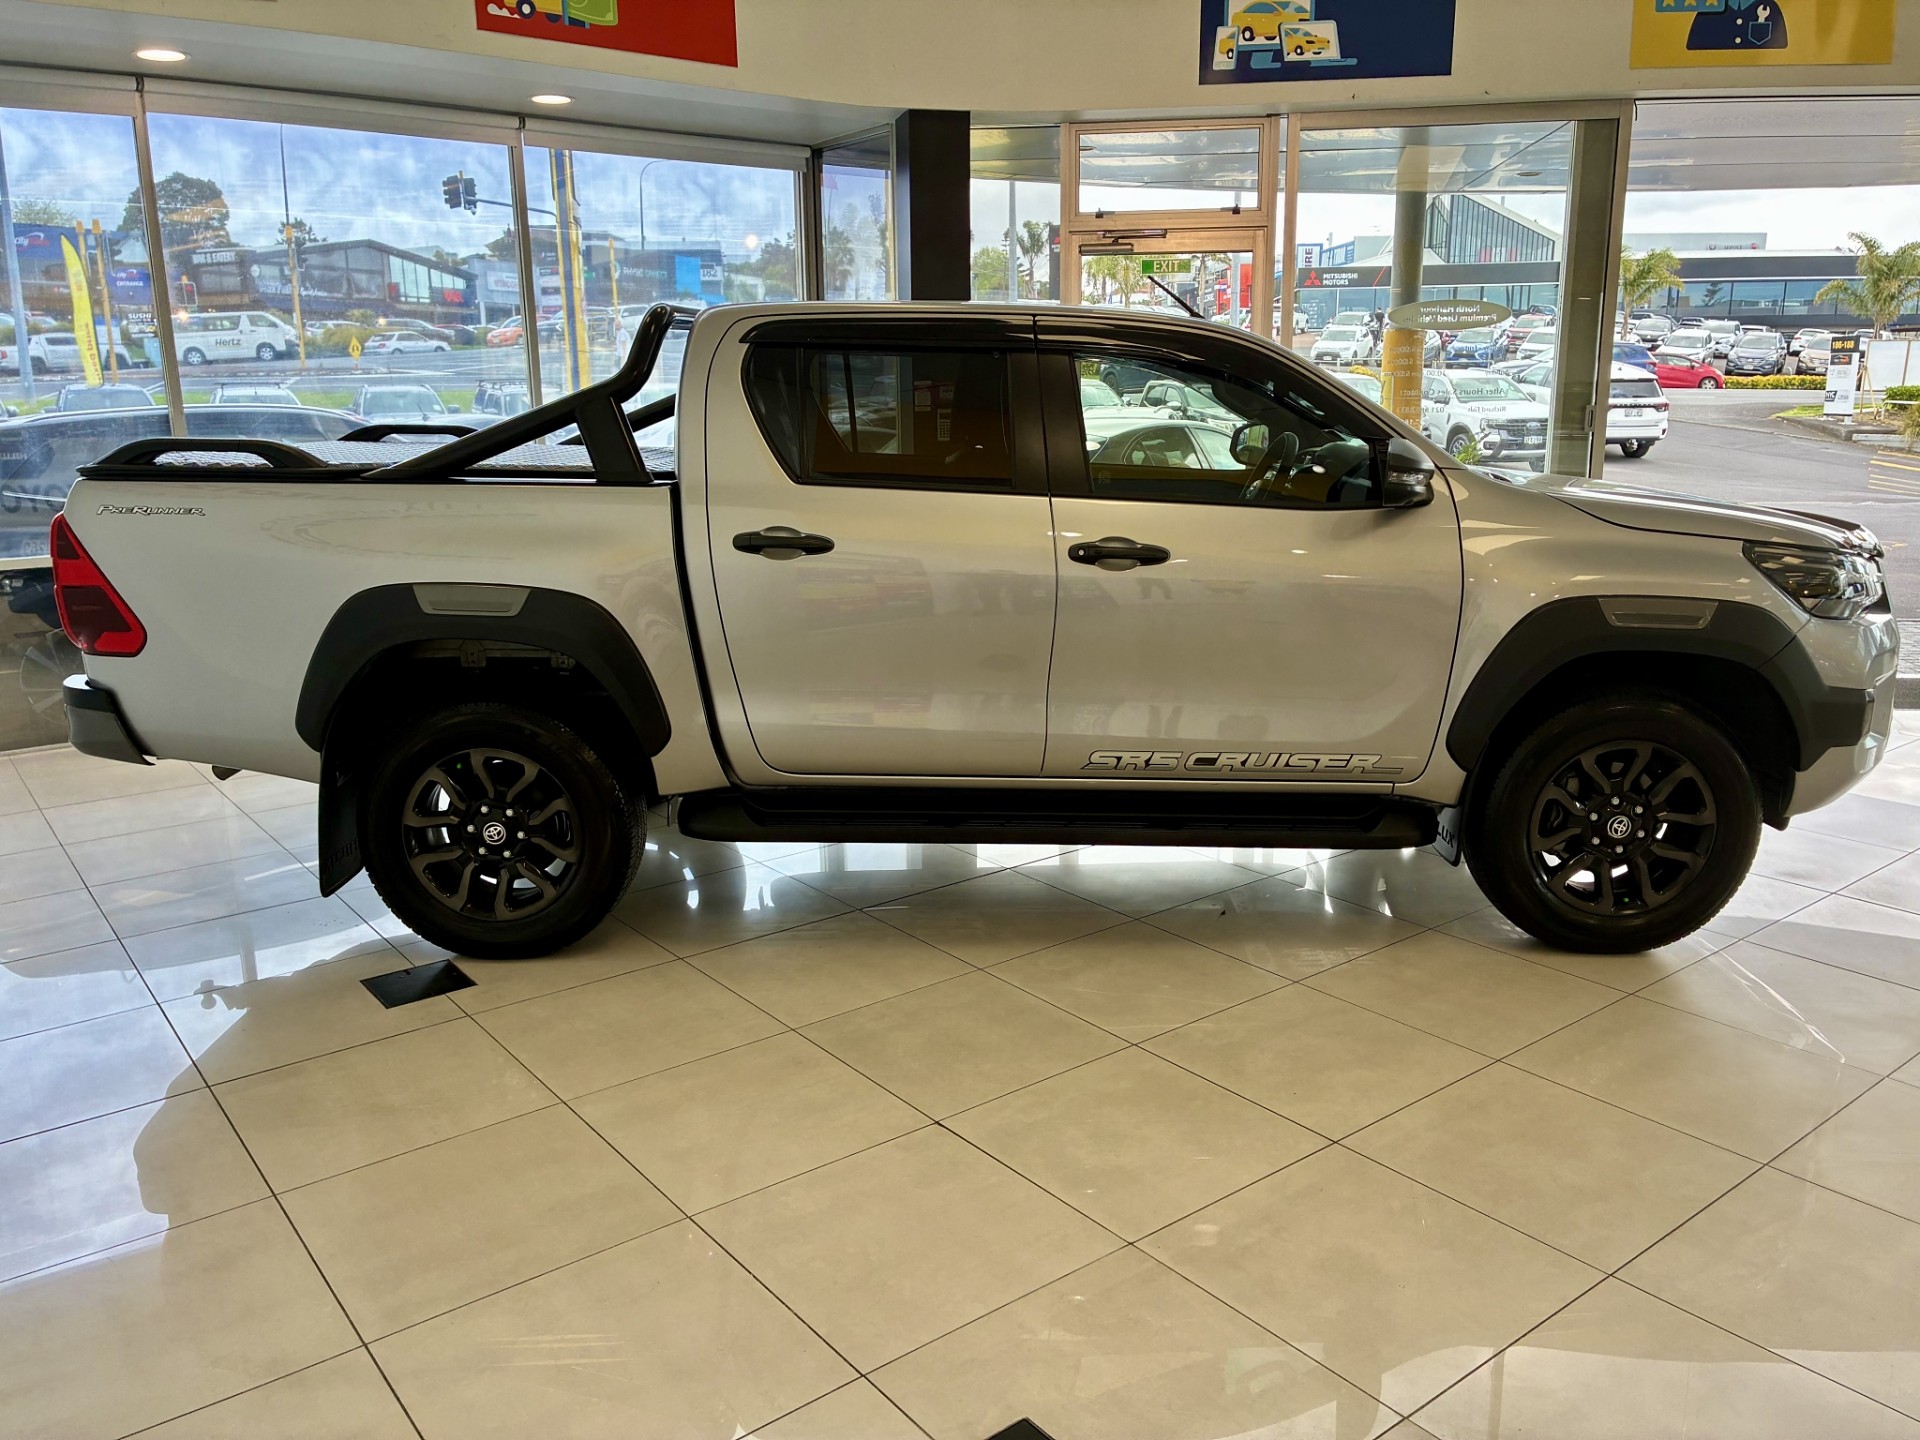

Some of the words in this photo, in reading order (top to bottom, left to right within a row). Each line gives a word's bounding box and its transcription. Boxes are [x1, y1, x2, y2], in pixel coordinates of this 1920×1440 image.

[1153, 260, 1180, 272] EXIT
[215, 338, 242, 346] Hertz
[1080, 750, 1183, 772] SR5
[1183, 752, 1405, 774] CRUISER
